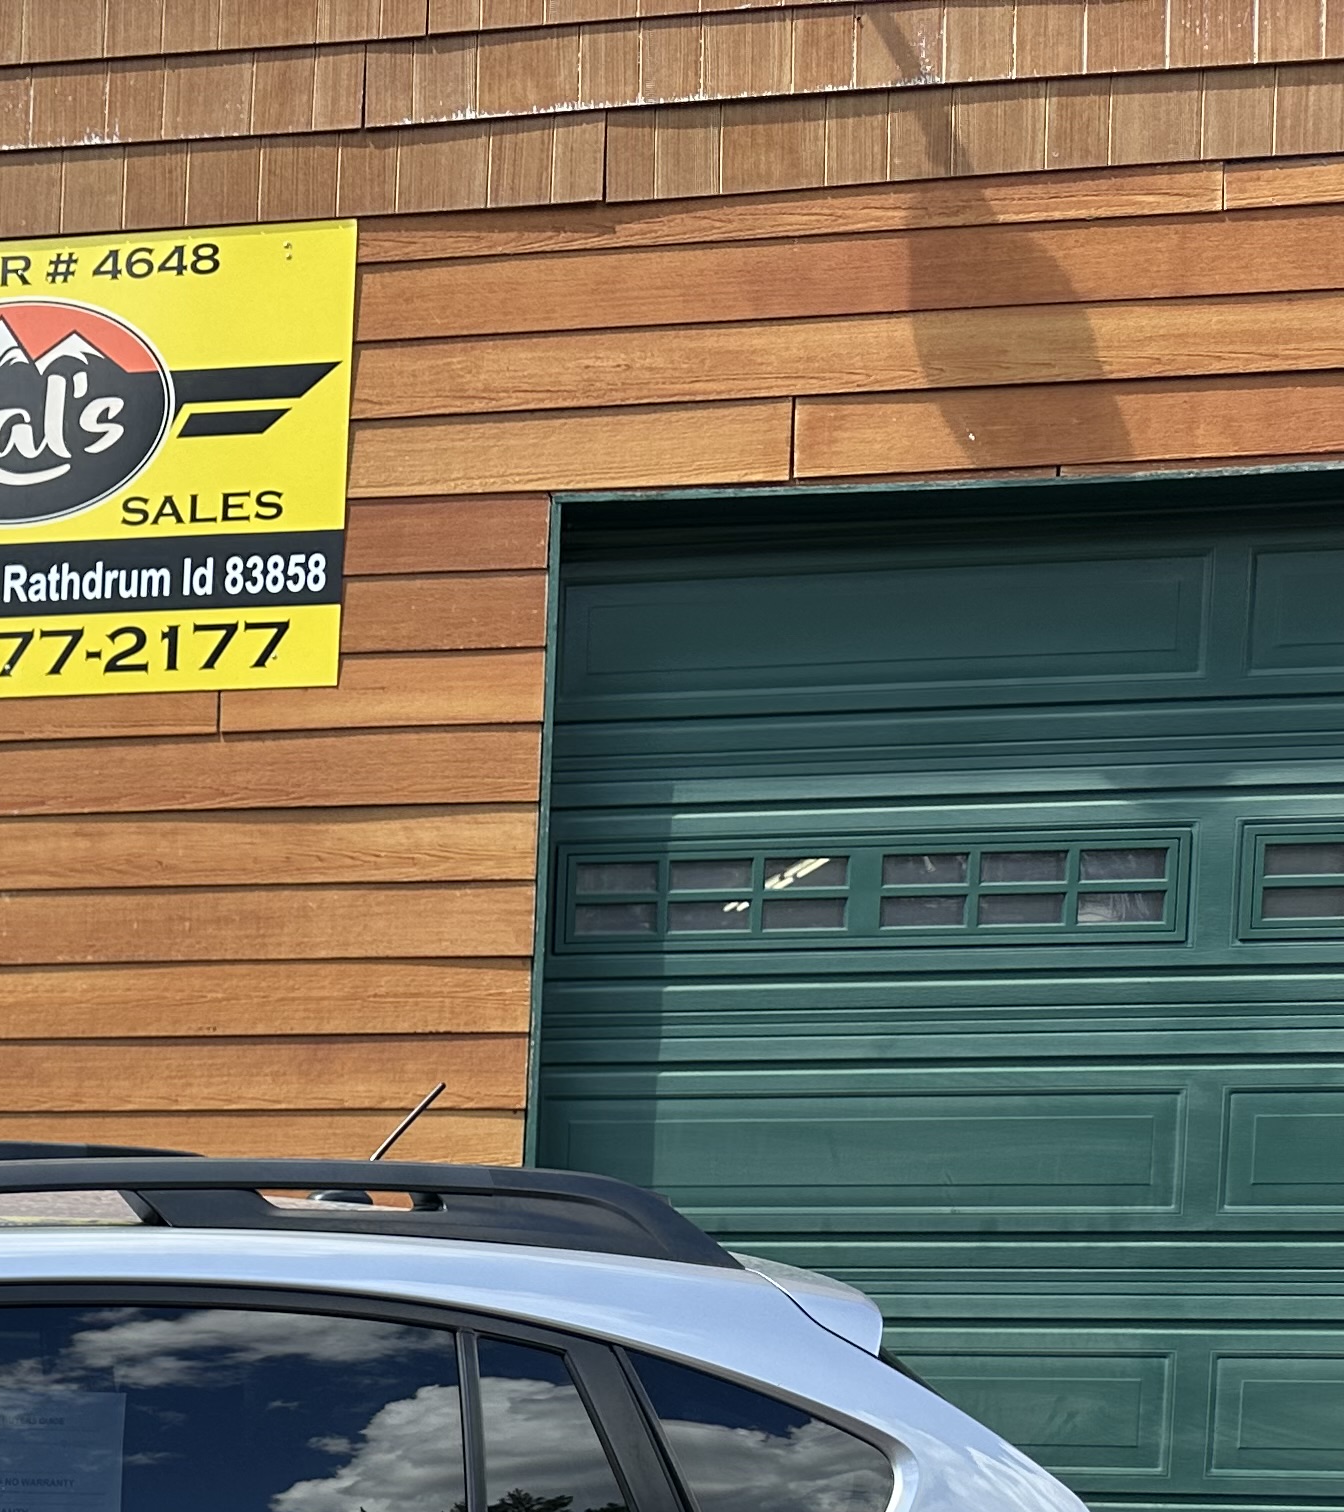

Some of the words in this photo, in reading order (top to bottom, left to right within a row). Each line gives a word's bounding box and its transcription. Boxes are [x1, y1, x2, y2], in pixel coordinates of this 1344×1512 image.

[46, 252, 78, 284] #
[92, 243, 222, 281] 4648
[121, 490, 285, 527] SALES
[2, 561, 170, 605] Rathdrum
[182, 557, 214, 597] Id
[224, 553, 328, 596] 83858
[4, 1477, 20, 1487] NO
[21, 1478, 75, 1489] WARRANTY
